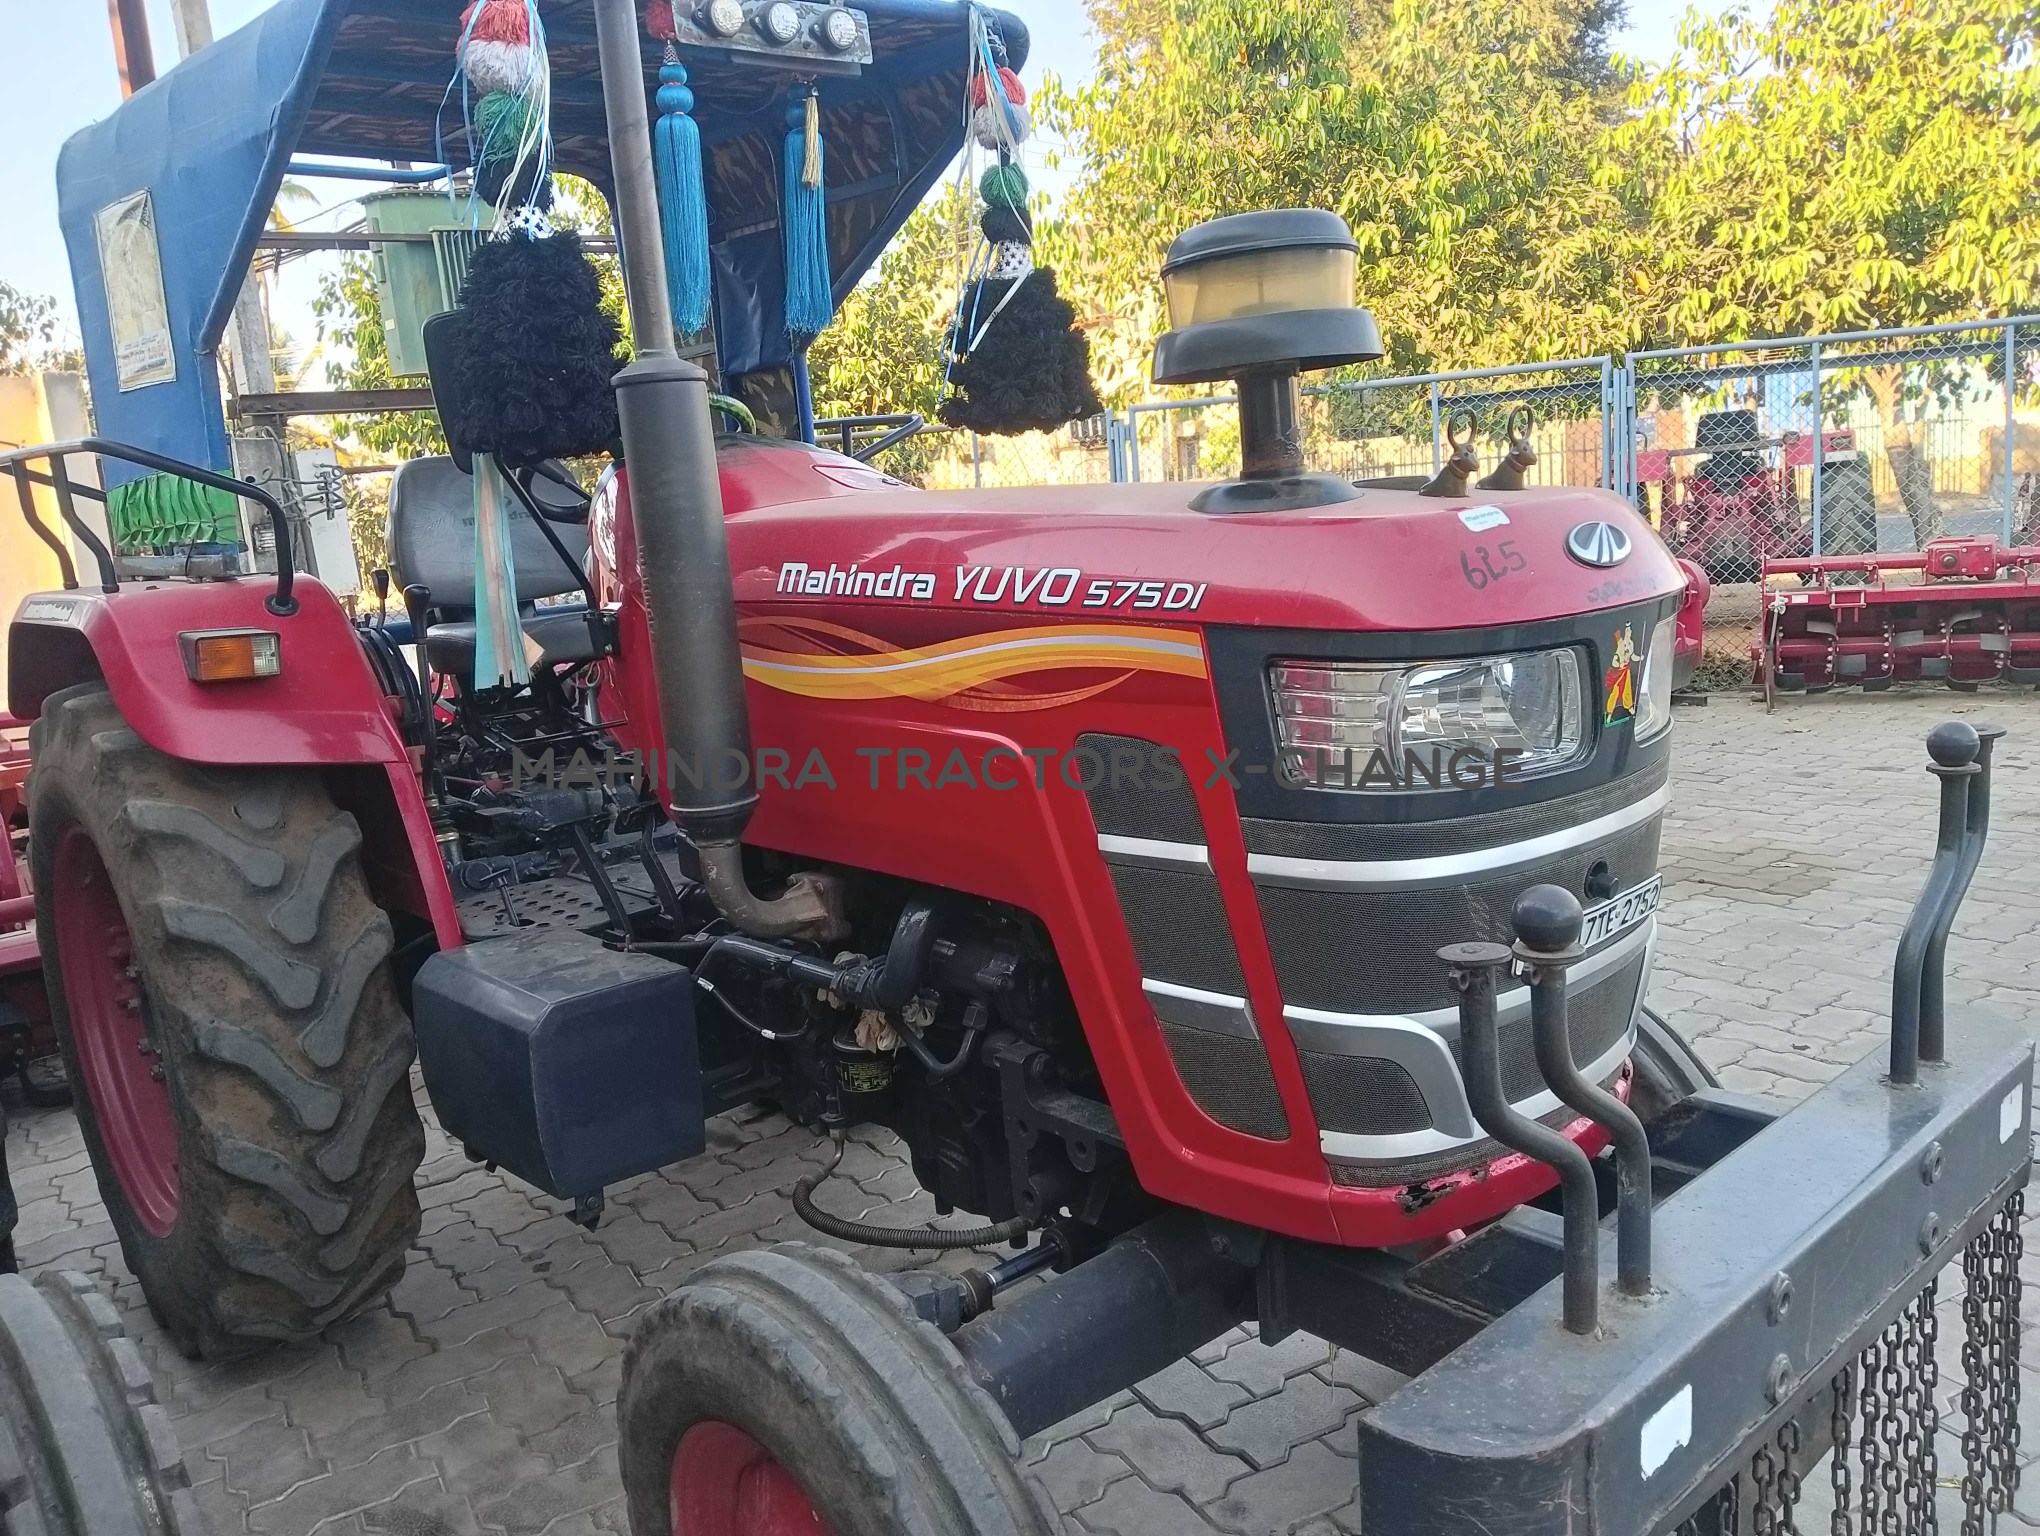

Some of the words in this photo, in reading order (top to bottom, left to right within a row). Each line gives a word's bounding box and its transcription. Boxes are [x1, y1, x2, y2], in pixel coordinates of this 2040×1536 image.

[776, 561, 937, 600] Mahindra
[953, 564, 1082, 605] YUVO
[1082, 580, 1208, 611] 575DI
